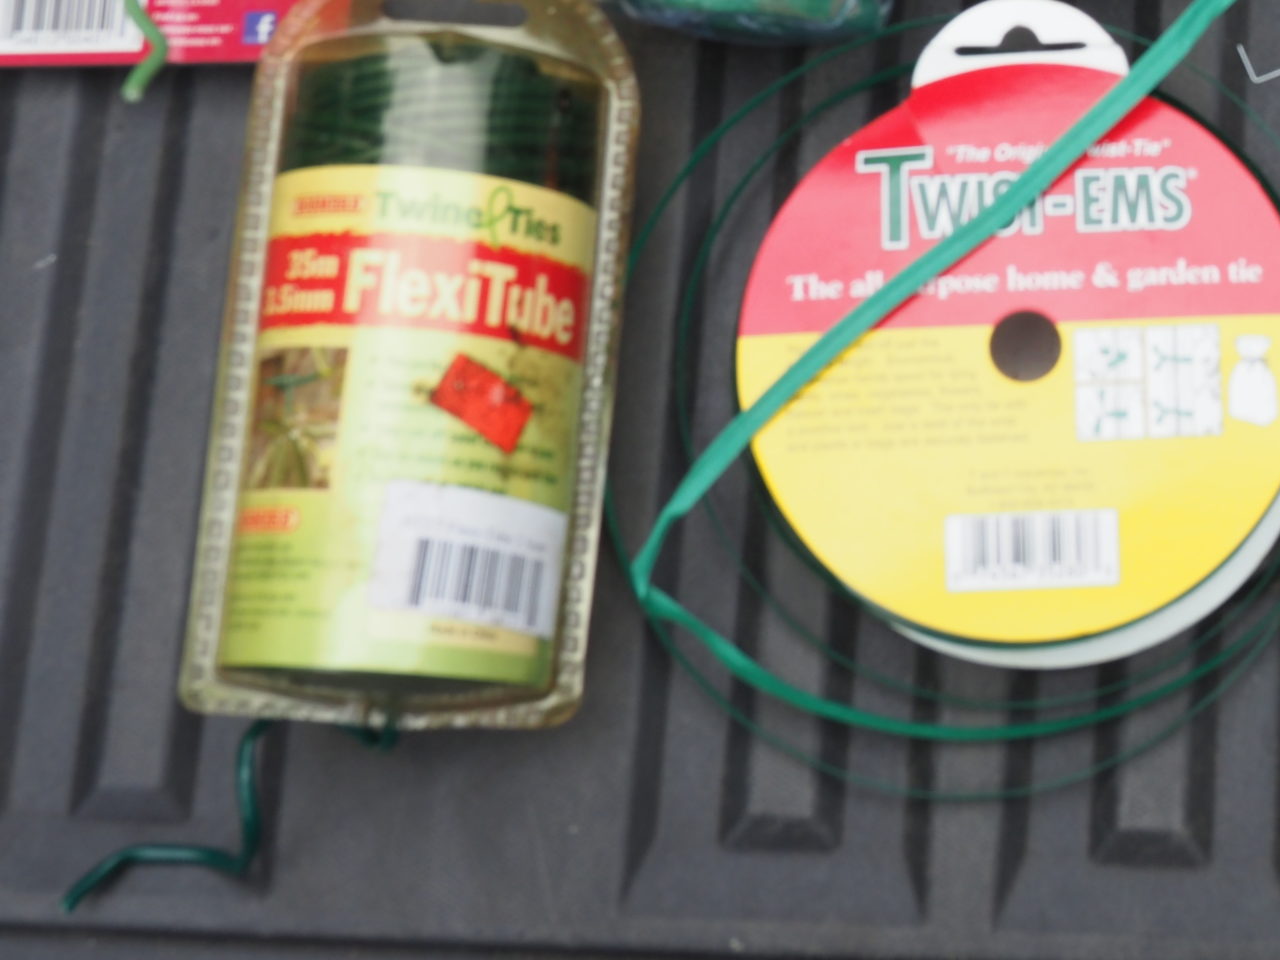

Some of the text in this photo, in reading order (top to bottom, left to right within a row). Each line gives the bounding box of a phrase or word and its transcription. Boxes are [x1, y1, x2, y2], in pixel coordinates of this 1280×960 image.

[377, 191, 484, 230] Twine
[509, 205, 563, 246] Ties
[341, 246, 577, 346] FlexiTube
[787, 273, 844, 301] The
[1006, 265, 1085, 293] home
[1091, 262, 1121, 289] &
[1126, 258, 1219, 292] garden
[1228, 257, 1263, 284] tie
